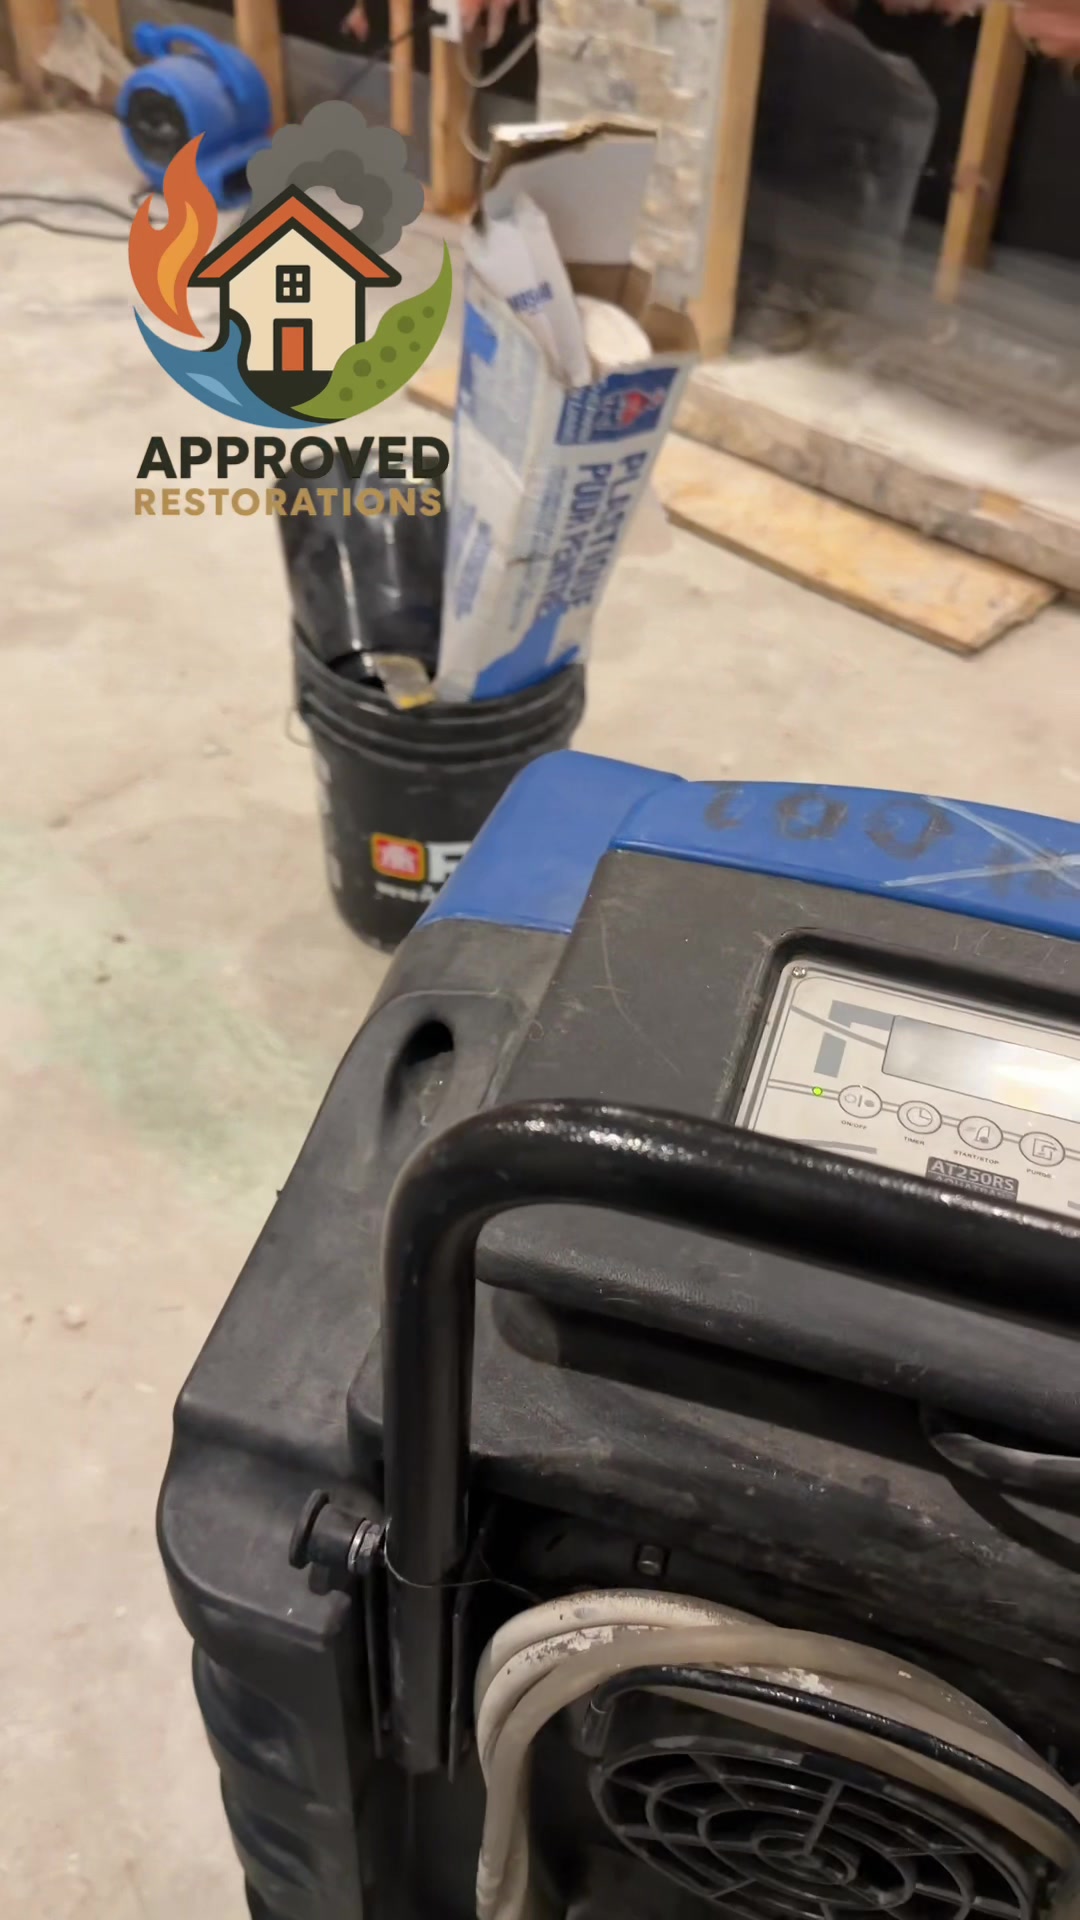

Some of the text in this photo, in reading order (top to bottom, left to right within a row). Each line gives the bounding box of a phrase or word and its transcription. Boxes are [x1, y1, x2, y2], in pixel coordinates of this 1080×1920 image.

[840, 1120, 867, 1130] ON/OFF
[904, 1136, 925, 1146] TIMER
[953, 1149, 1000, 1165] START/STOP
[931, 1160, 1015, 1191] AT250RS
[1026, 1168, 1052, 1179] PURGE
